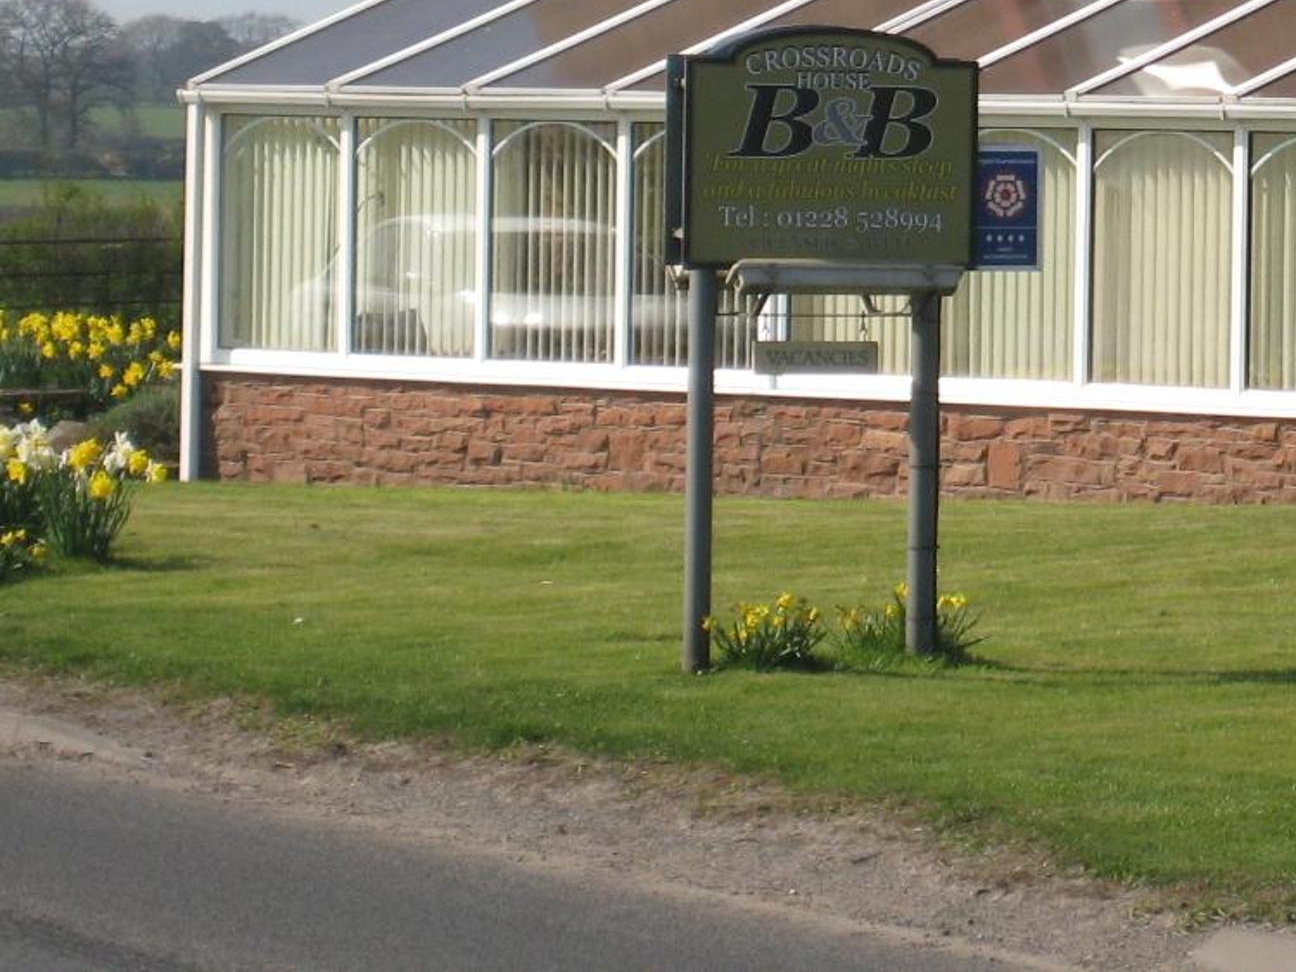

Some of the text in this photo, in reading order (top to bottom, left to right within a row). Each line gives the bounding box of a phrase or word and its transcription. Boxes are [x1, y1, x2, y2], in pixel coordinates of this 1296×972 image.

[745, 45, 922, 81] CROSSROADS
[796, 71, 873, 90] HOUSE
[725, 83, 939, 161] B&B
[702, 179, 745, 198] and
[775, 206, 847, 229] 01228
[854, 206, 943, 234] 528994
[764, 347, 869, 367] VACANCIES
